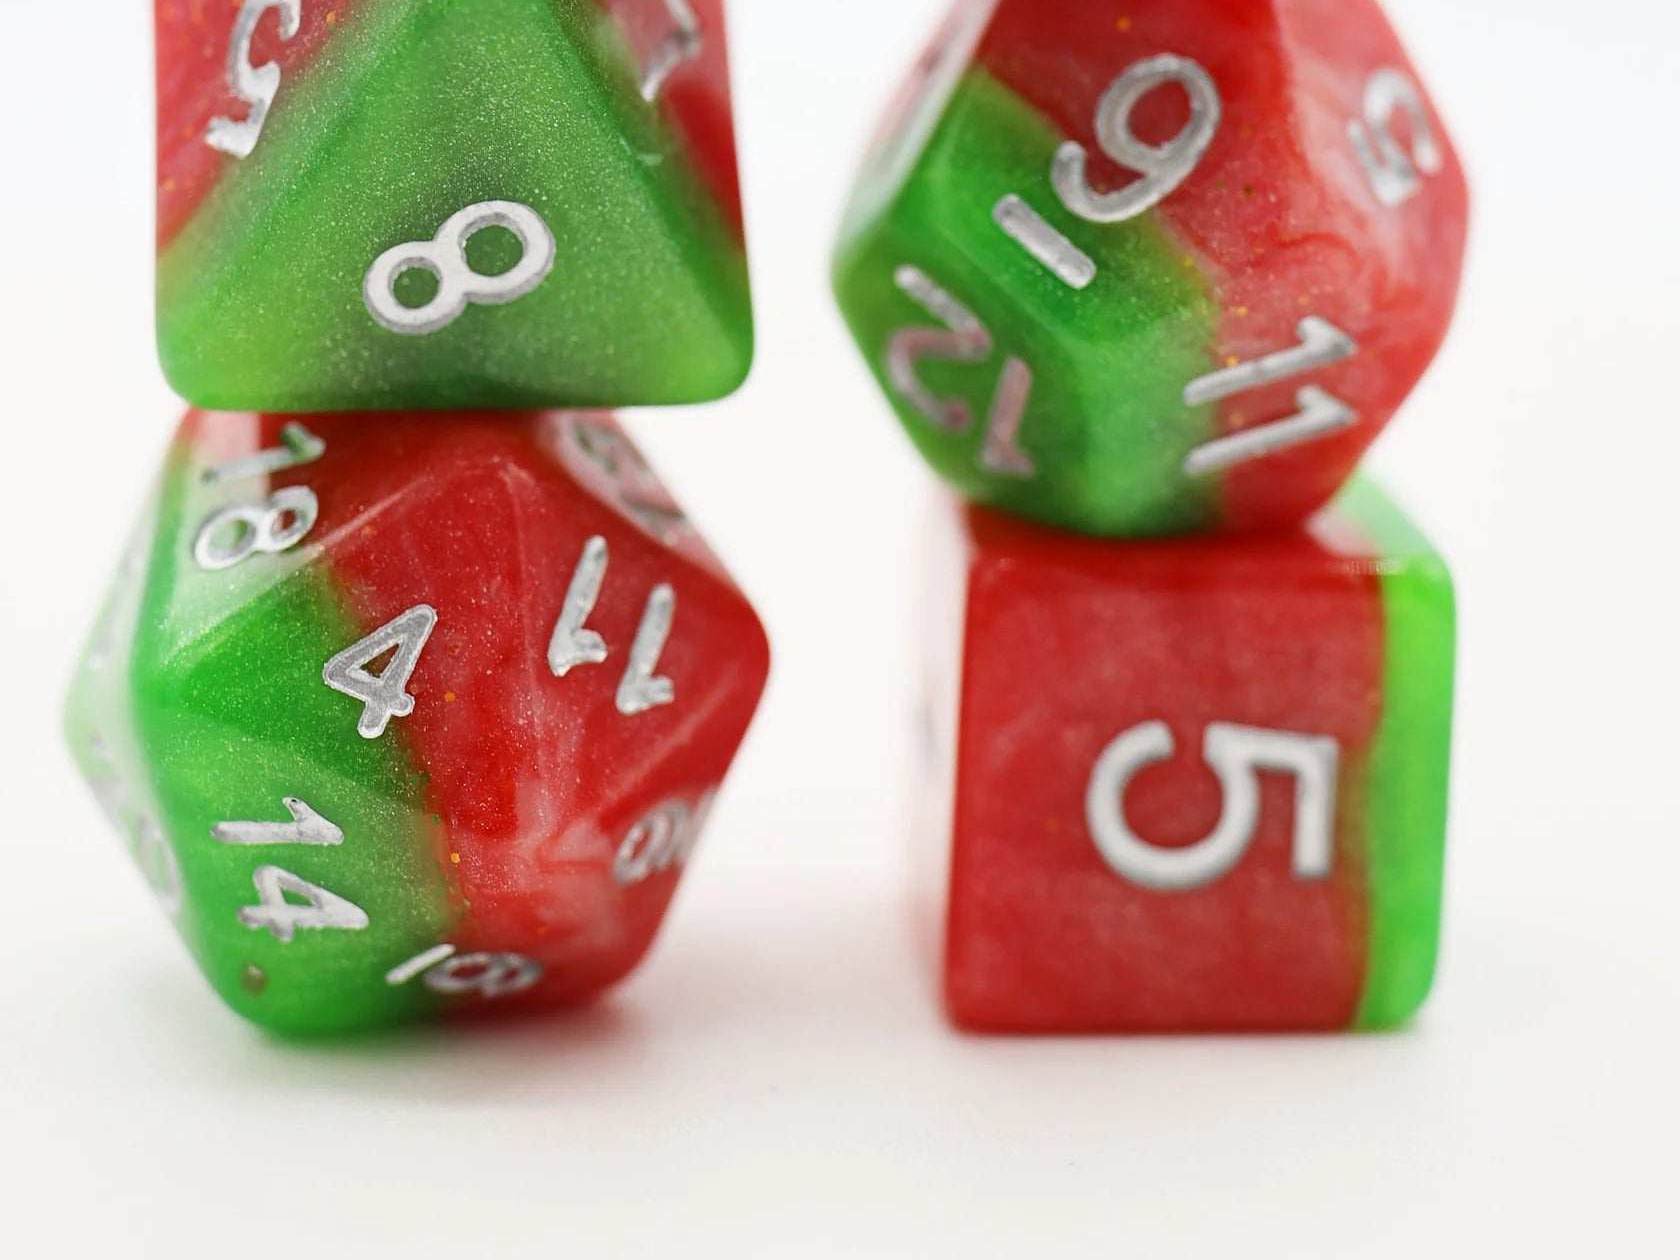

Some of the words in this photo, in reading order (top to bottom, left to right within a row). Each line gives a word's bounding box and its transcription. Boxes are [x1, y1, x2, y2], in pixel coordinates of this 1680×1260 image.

[363, 199, 557, 336] 8
[886, 263, 1037, 479] 12
[1182, 315, 1358, 479] 11
[192, 420, 327, 573] 18
[322, 603, 439, 740] 4
[210, 795, 370, 942] 14
[1084, 718, 1340, 892] 5
